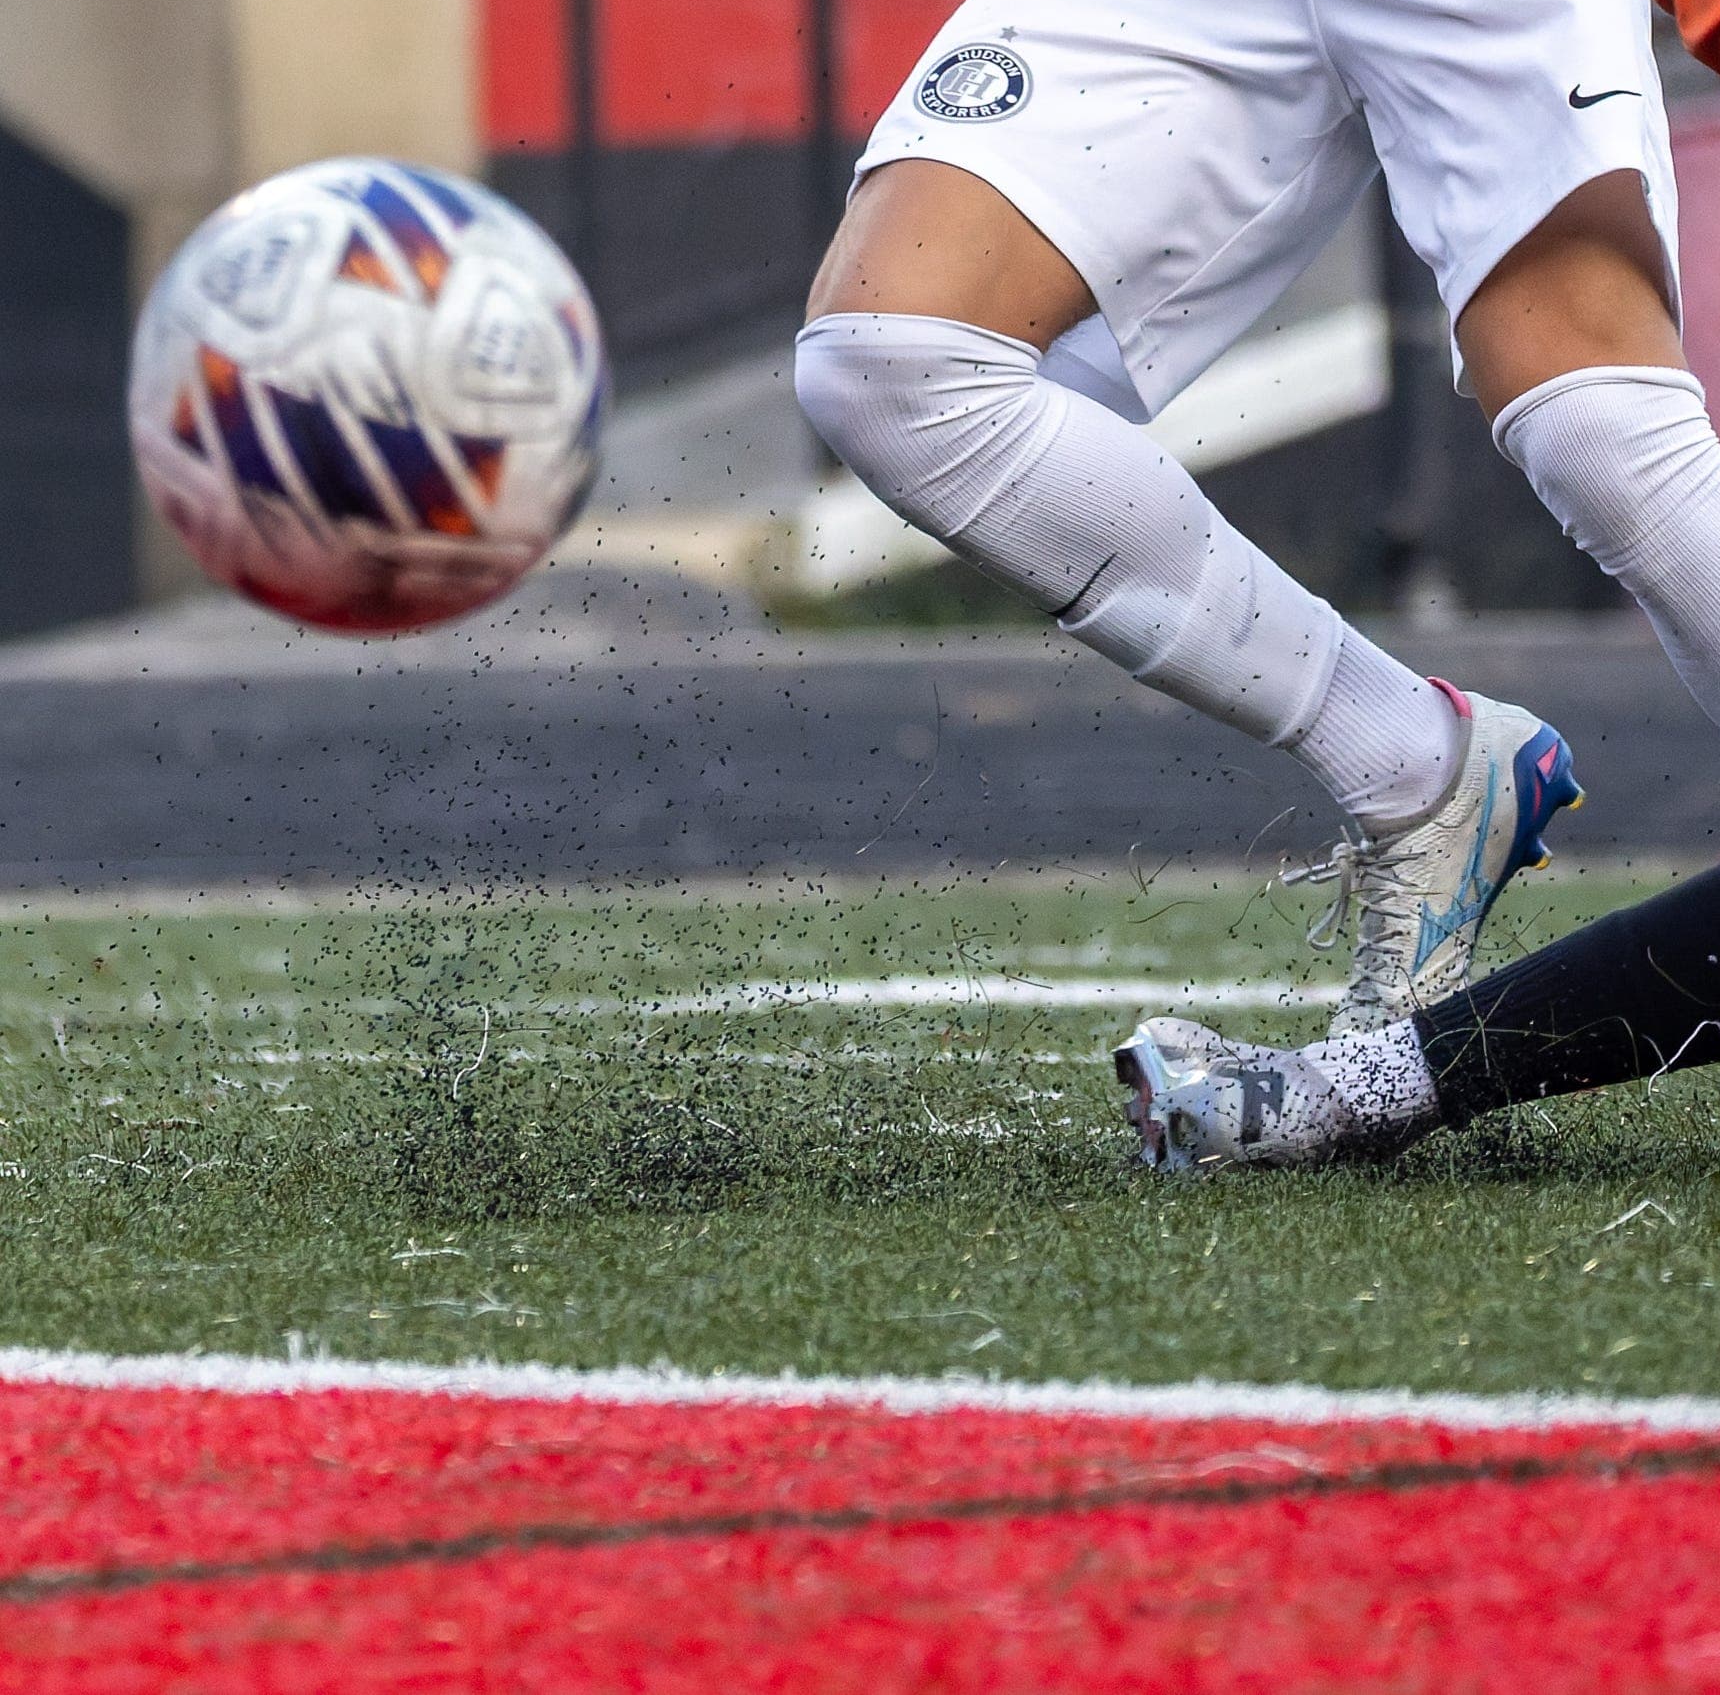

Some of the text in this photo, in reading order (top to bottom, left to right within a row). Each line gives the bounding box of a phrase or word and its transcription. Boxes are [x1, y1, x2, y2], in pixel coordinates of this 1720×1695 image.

[957, 48, 1021, 77] HUDSON
[941, 65, 1000, 100] H
[922, 88, 1003, 117] EXPLORERS
